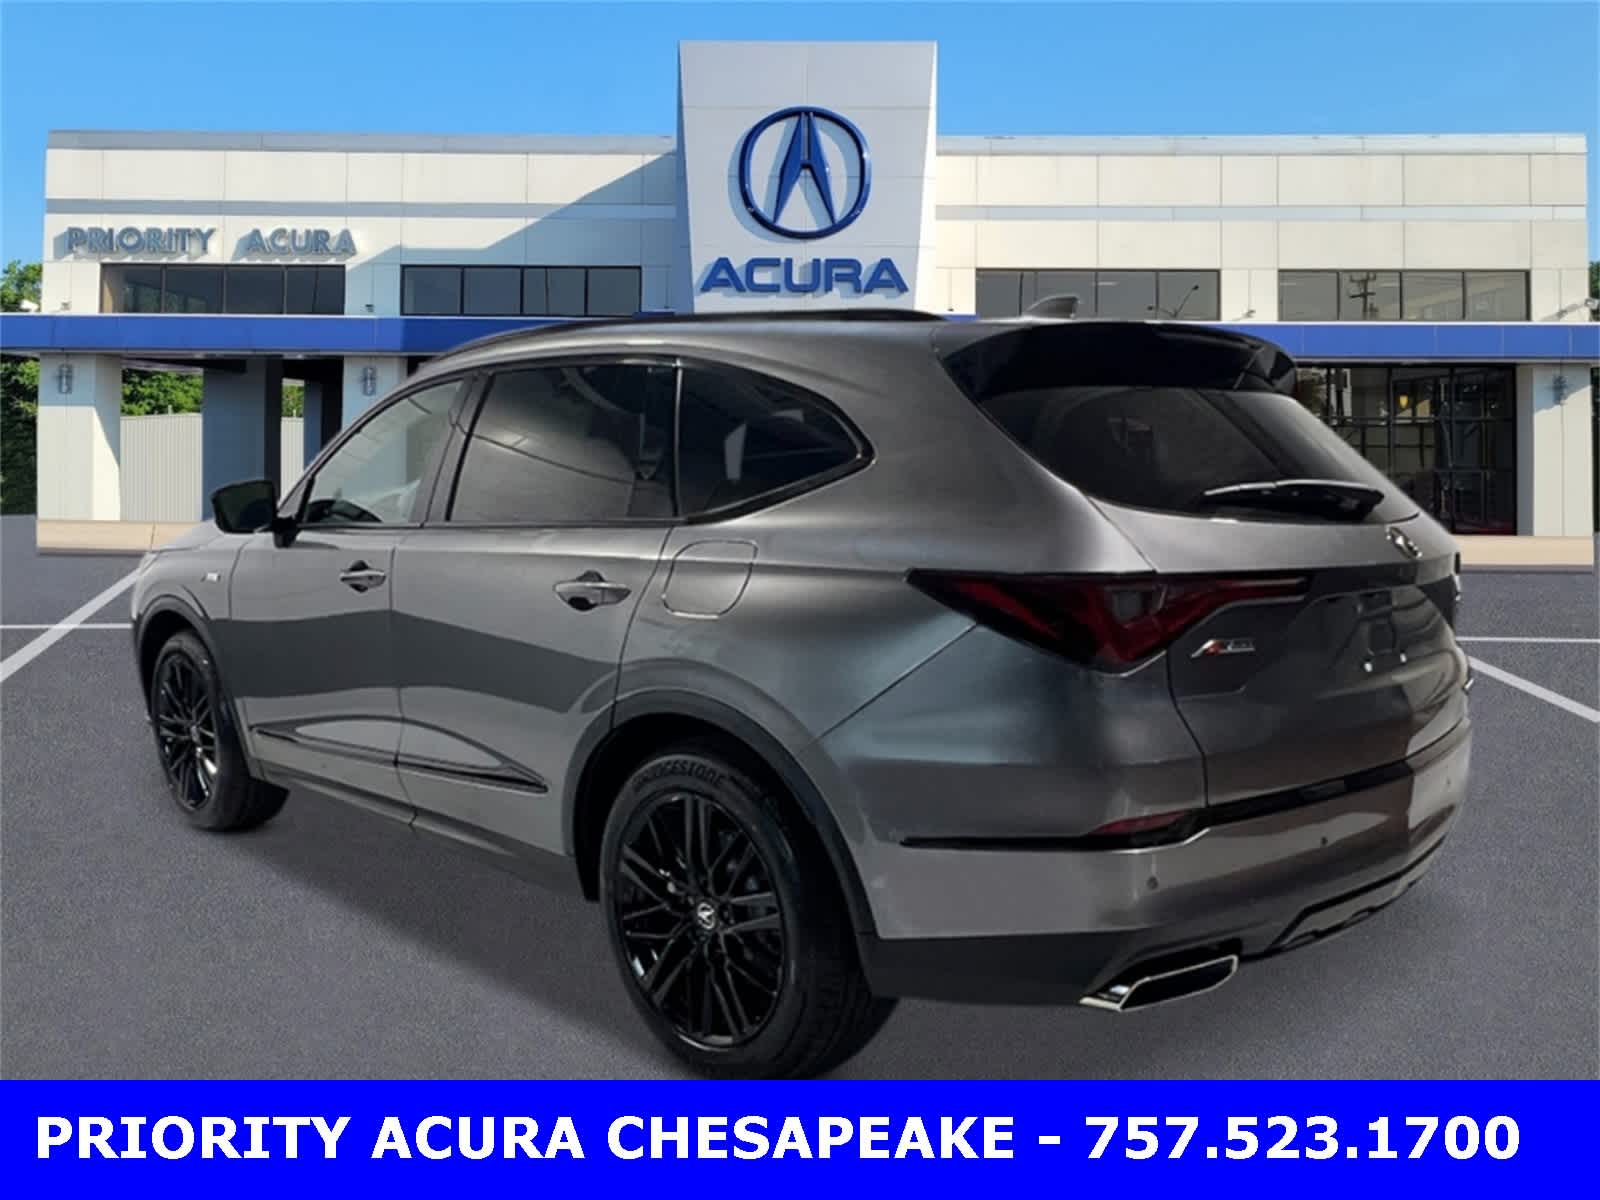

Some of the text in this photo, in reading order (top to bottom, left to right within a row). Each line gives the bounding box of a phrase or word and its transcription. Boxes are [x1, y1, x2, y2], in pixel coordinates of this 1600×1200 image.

[66, 226, 358, 255] PRIORITY ACURA
[700, 256, 909, 295] ACURA
[632, 759, 727, 792] DGESTONE
